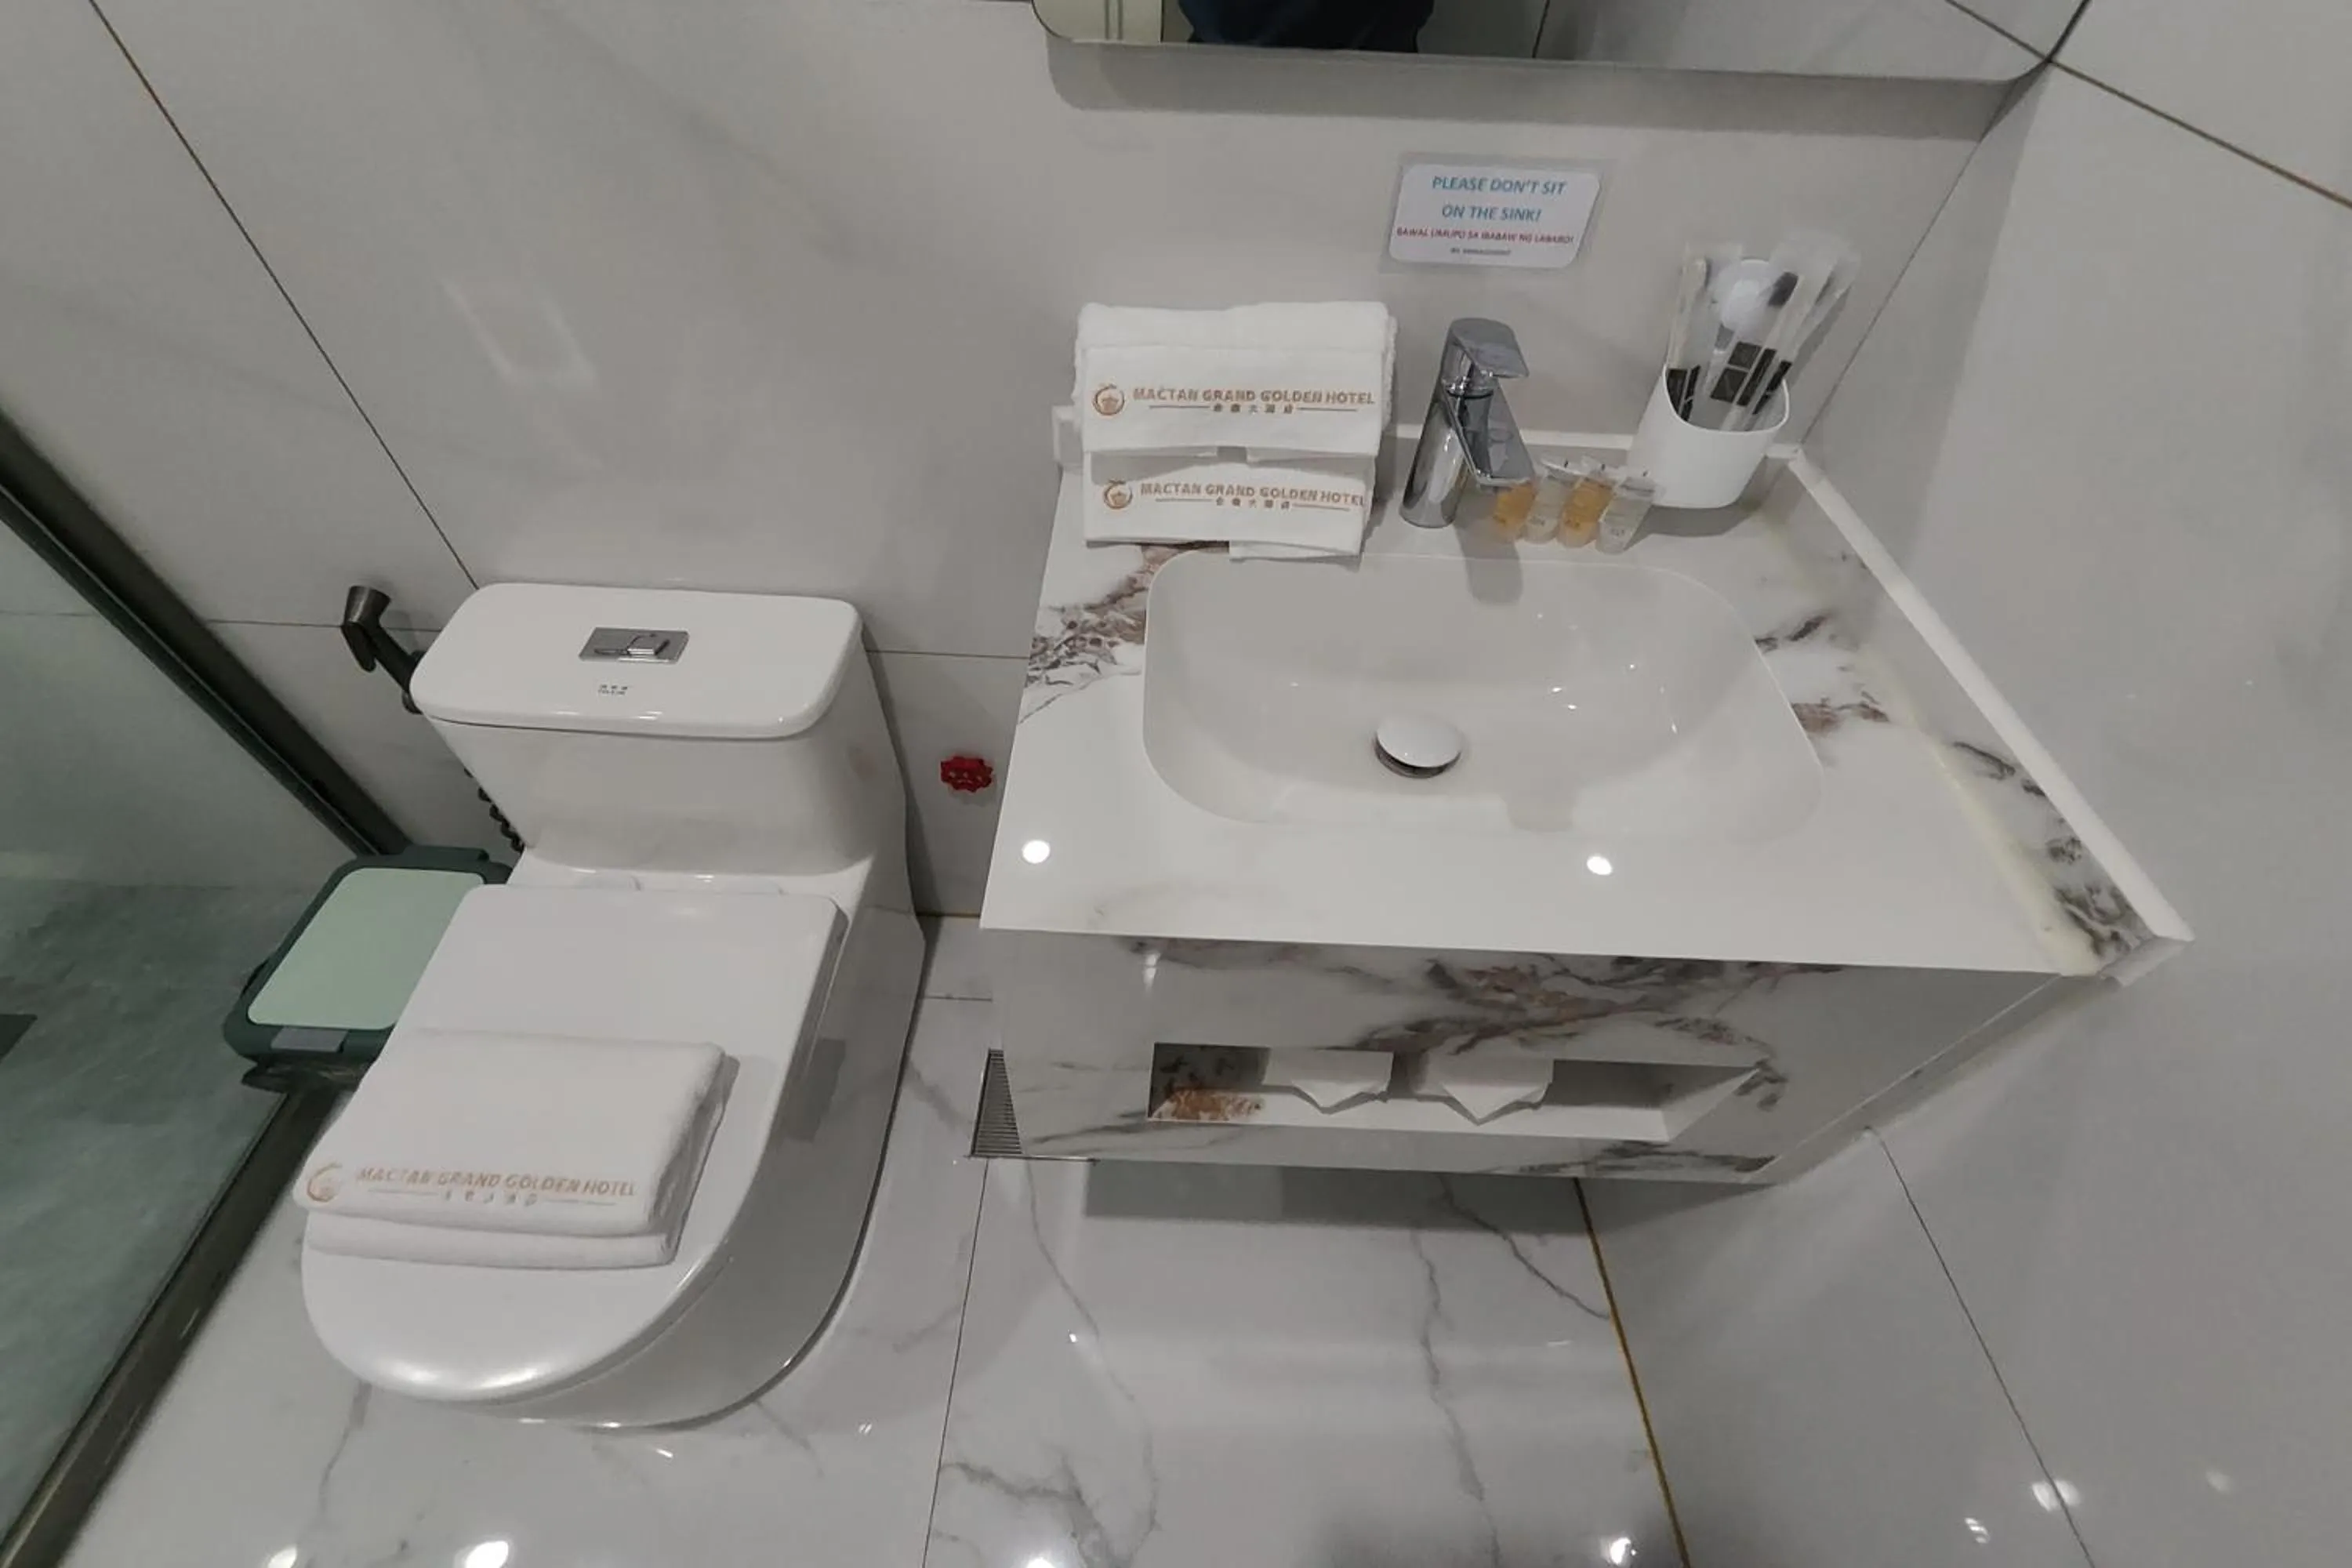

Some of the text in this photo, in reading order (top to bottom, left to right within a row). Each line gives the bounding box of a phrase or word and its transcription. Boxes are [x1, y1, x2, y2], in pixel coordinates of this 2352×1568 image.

[1432, 176, 1567, 194] PLEASE DON'T SIT
[1442, 204, 1542, 222] ON THE SINK!
[1133, 388, 1374, 405] MACTAN GRAND GOLDEN HOTEL
[1140, 482, 1364, 506] MACTAN GRAND GOLDEN HOTEL
[356, 1167, 636, 1196] MACTAN GRAND GOLDEN HOTEL
